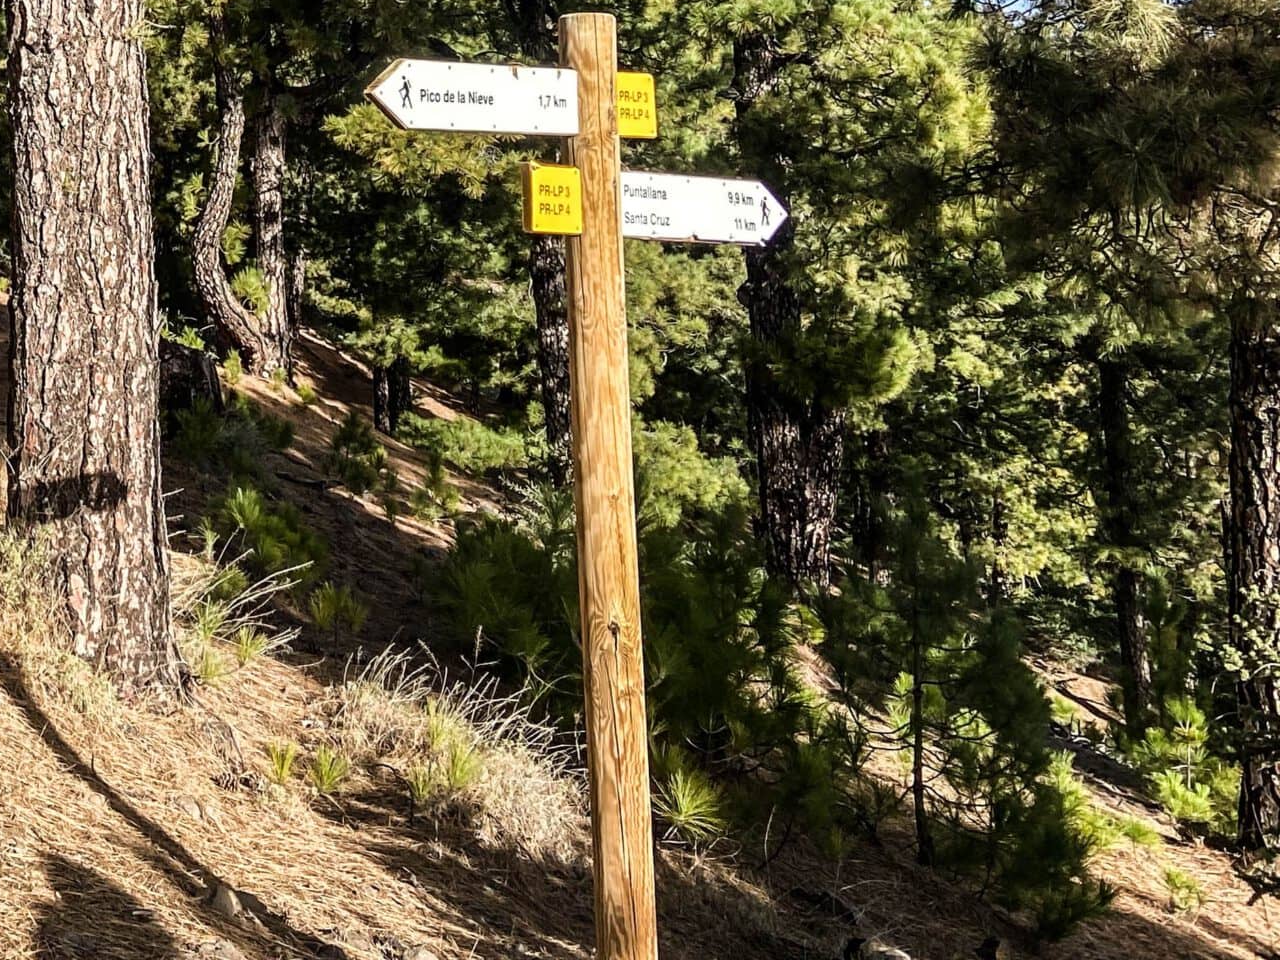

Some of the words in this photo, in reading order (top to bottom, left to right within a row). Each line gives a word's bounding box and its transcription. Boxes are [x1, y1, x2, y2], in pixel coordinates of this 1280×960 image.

[419, 88, 441, 103] Pico
[443, 90, 455, 104] de
[457, 91, 466, 105] la
[468, 91, 494, 106] Nieve
[538, 95, 551, 109] 1,7
[553, 96, 567, 108] km
[618, 90, 643, 103] PR-LP
[643, 92, 649, 103] 3
[619, 108, 643, 120] PR-LP
[644, 109, 650, 121] 4
[538, 184, 564, 197] PR-LP
[565, 186, 571, 198] 3
[623, 184, 667, 200] Puntallana
[727, 191, 740, 205] 9,9
[741, 193, 754, 206] km
[539, 203, 564, 215] PR-LP
[565, 204, 571, 216] 4
[624, 211, 648, 225] Santa
[650, 213, 670, 226] Cruz
[734, 218, 743, 230] 11
[744, 219, 757, 231] km
